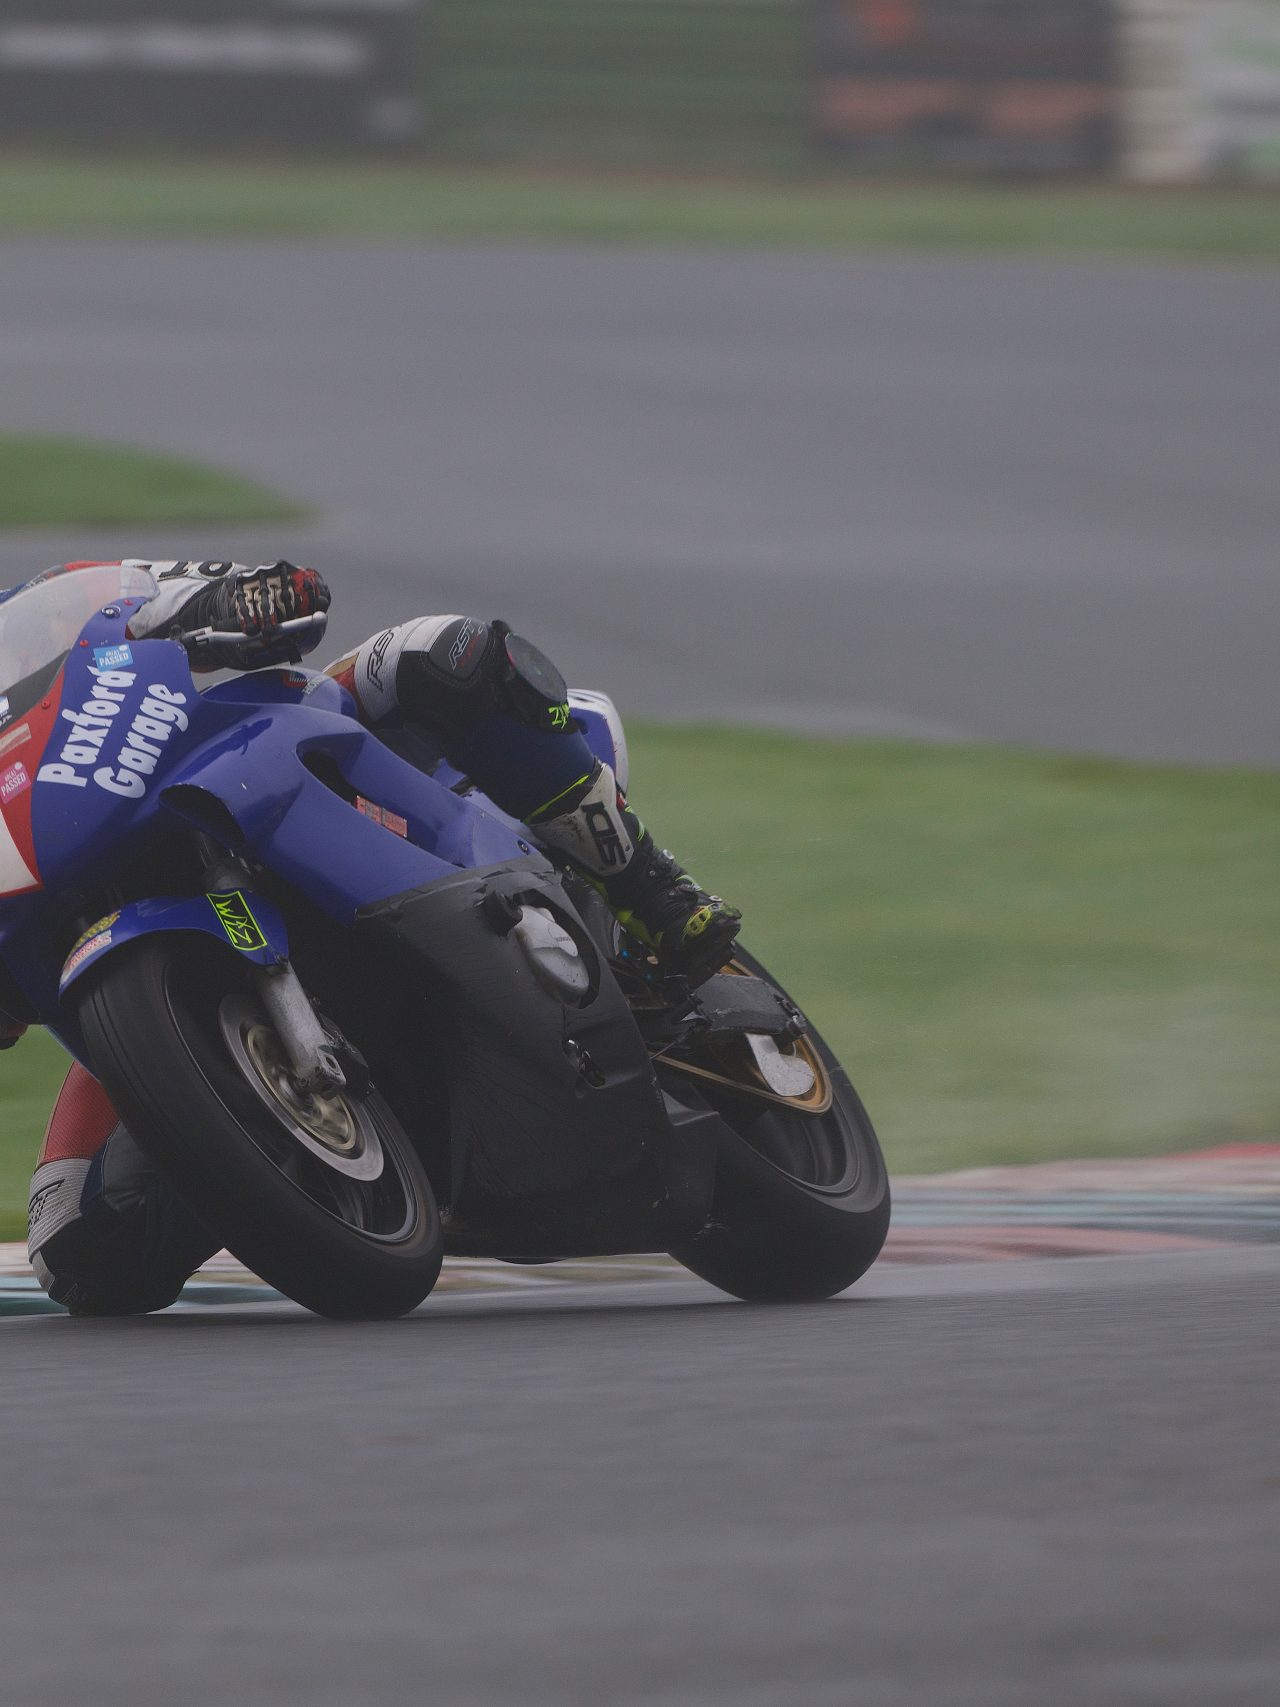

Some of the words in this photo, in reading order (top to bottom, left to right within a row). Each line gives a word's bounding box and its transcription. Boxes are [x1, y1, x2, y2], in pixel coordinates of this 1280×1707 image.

[99, 652, 129, 666] PASSED
[366, 628, 395, 694] RS
[36, 664, 137, 788] Paxford
[93, 683, 189, 799] Garage
[0, 771, 26, 797] PASSED
